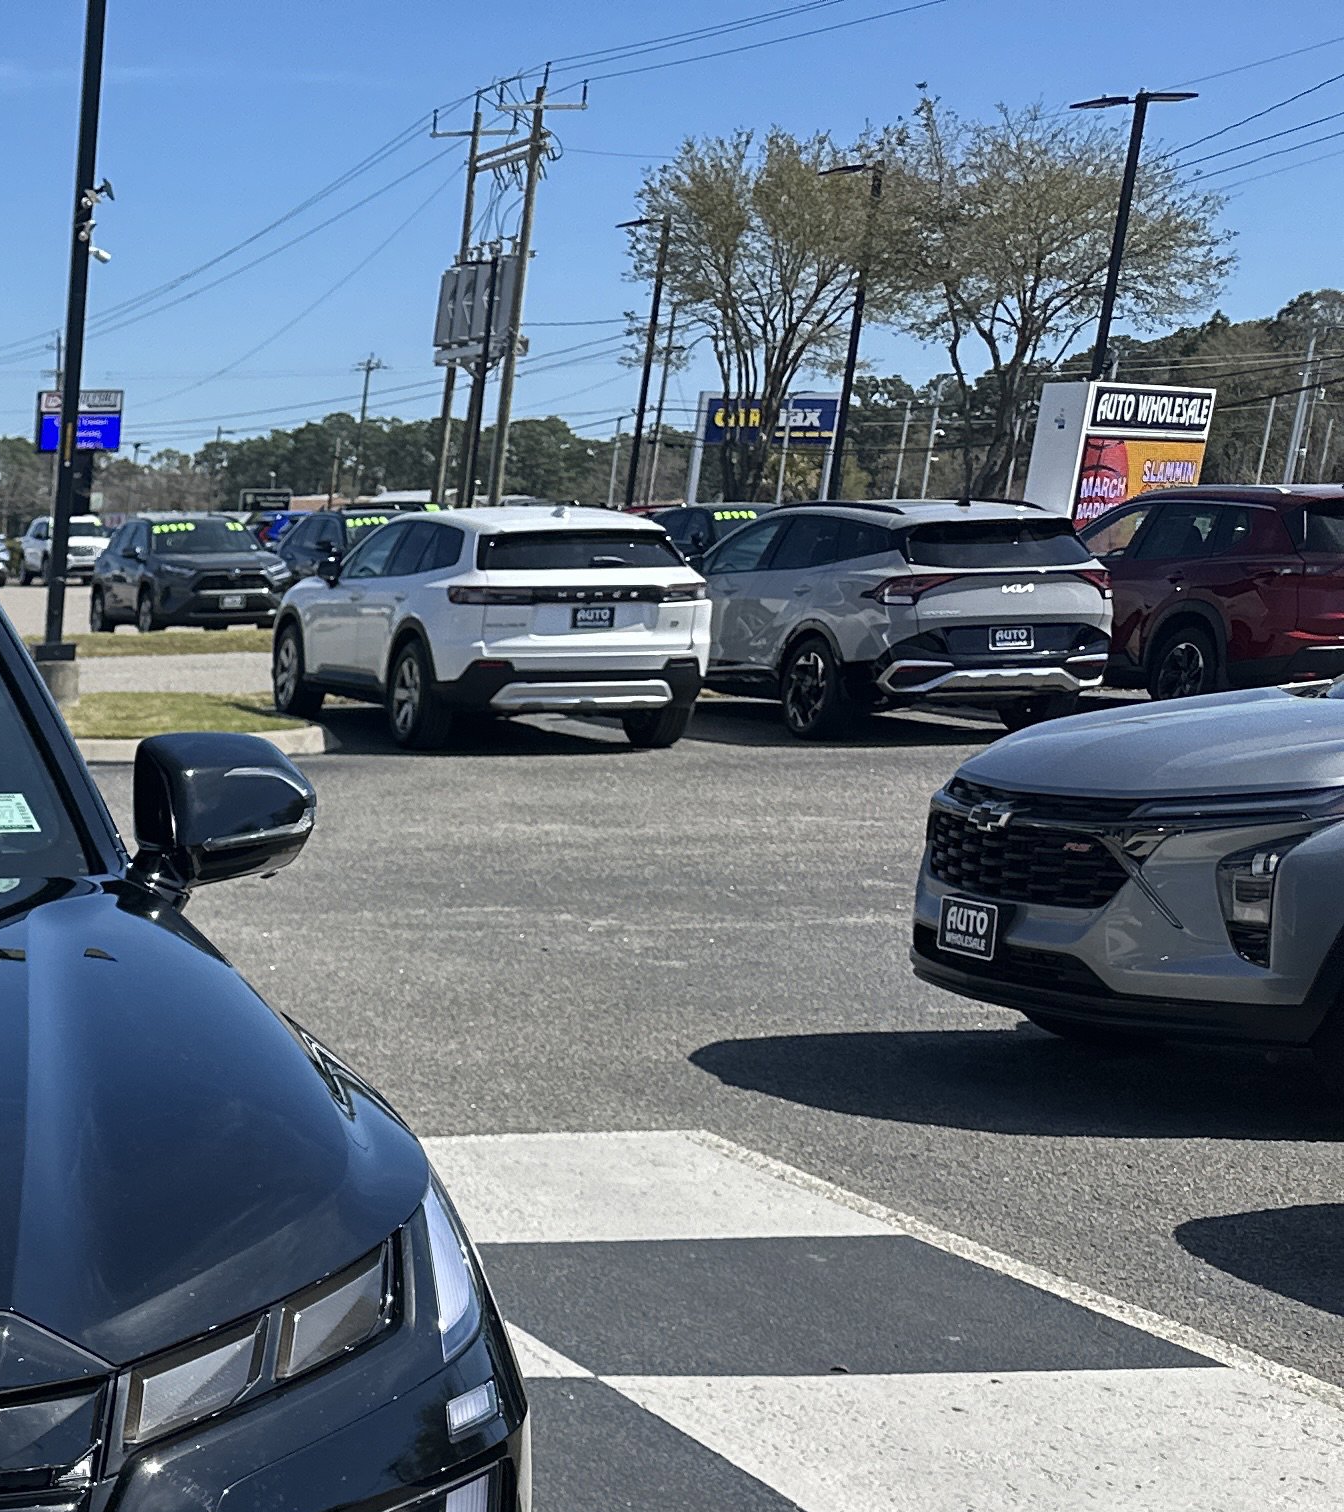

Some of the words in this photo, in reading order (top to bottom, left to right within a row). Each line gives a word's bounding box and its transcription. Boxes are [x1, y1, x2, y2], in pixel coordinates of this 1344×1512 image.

[1097, 393, 1135, 422] AUTO
[1137, 396, 1209, 426] WHOLESALE
[1142, 460, 1197, 483] SLAMMIN
[1080, 476, 1126, 498] MARCH
[576, 608, 611, 621] AUTO
[995, 629, 1027, 641] AUTO
[946, 906, 989, 935] AUTO
[945, 931, 986, 951] WHOLESALE
